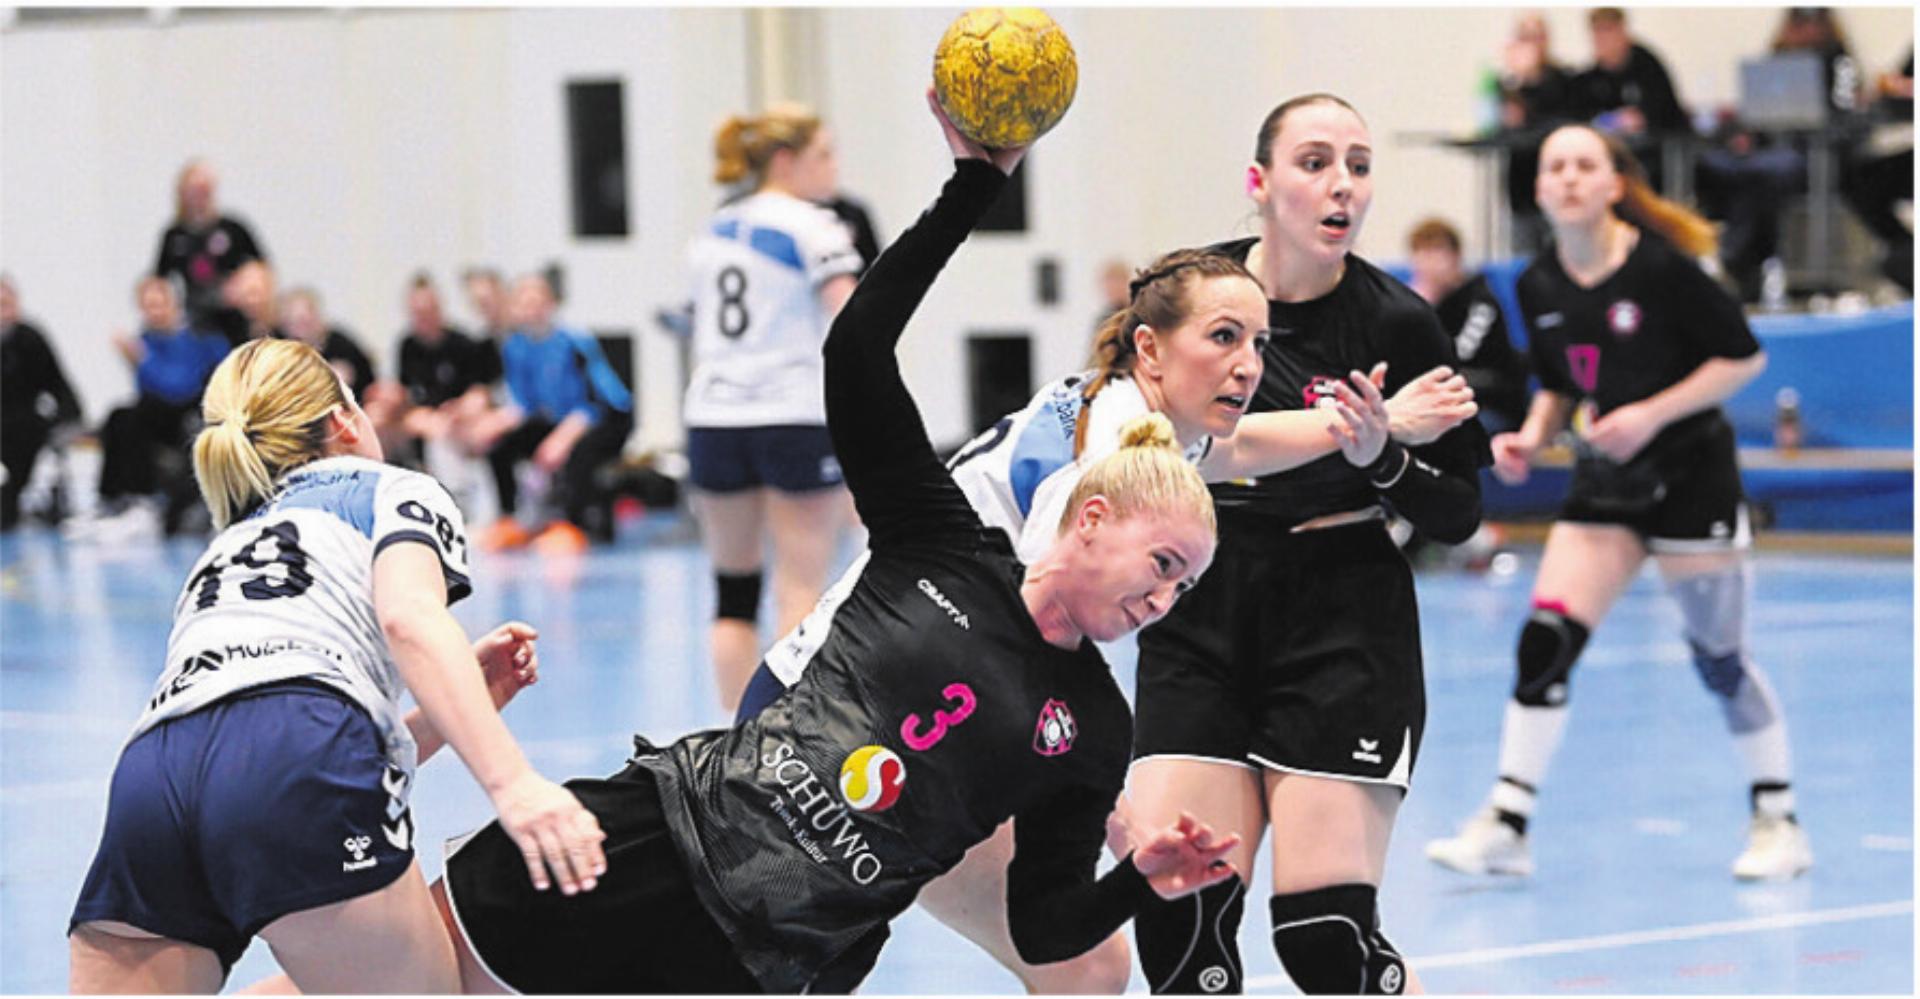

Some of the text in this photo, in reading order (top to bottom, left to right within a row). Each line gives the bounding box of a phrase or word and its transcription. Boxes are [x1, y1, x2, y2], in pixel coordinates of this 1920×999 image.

[717, 266, 749, 339] 8
[900, 683, 977, 751] 3
[761, 743, 882, 885] SCHÜWO
